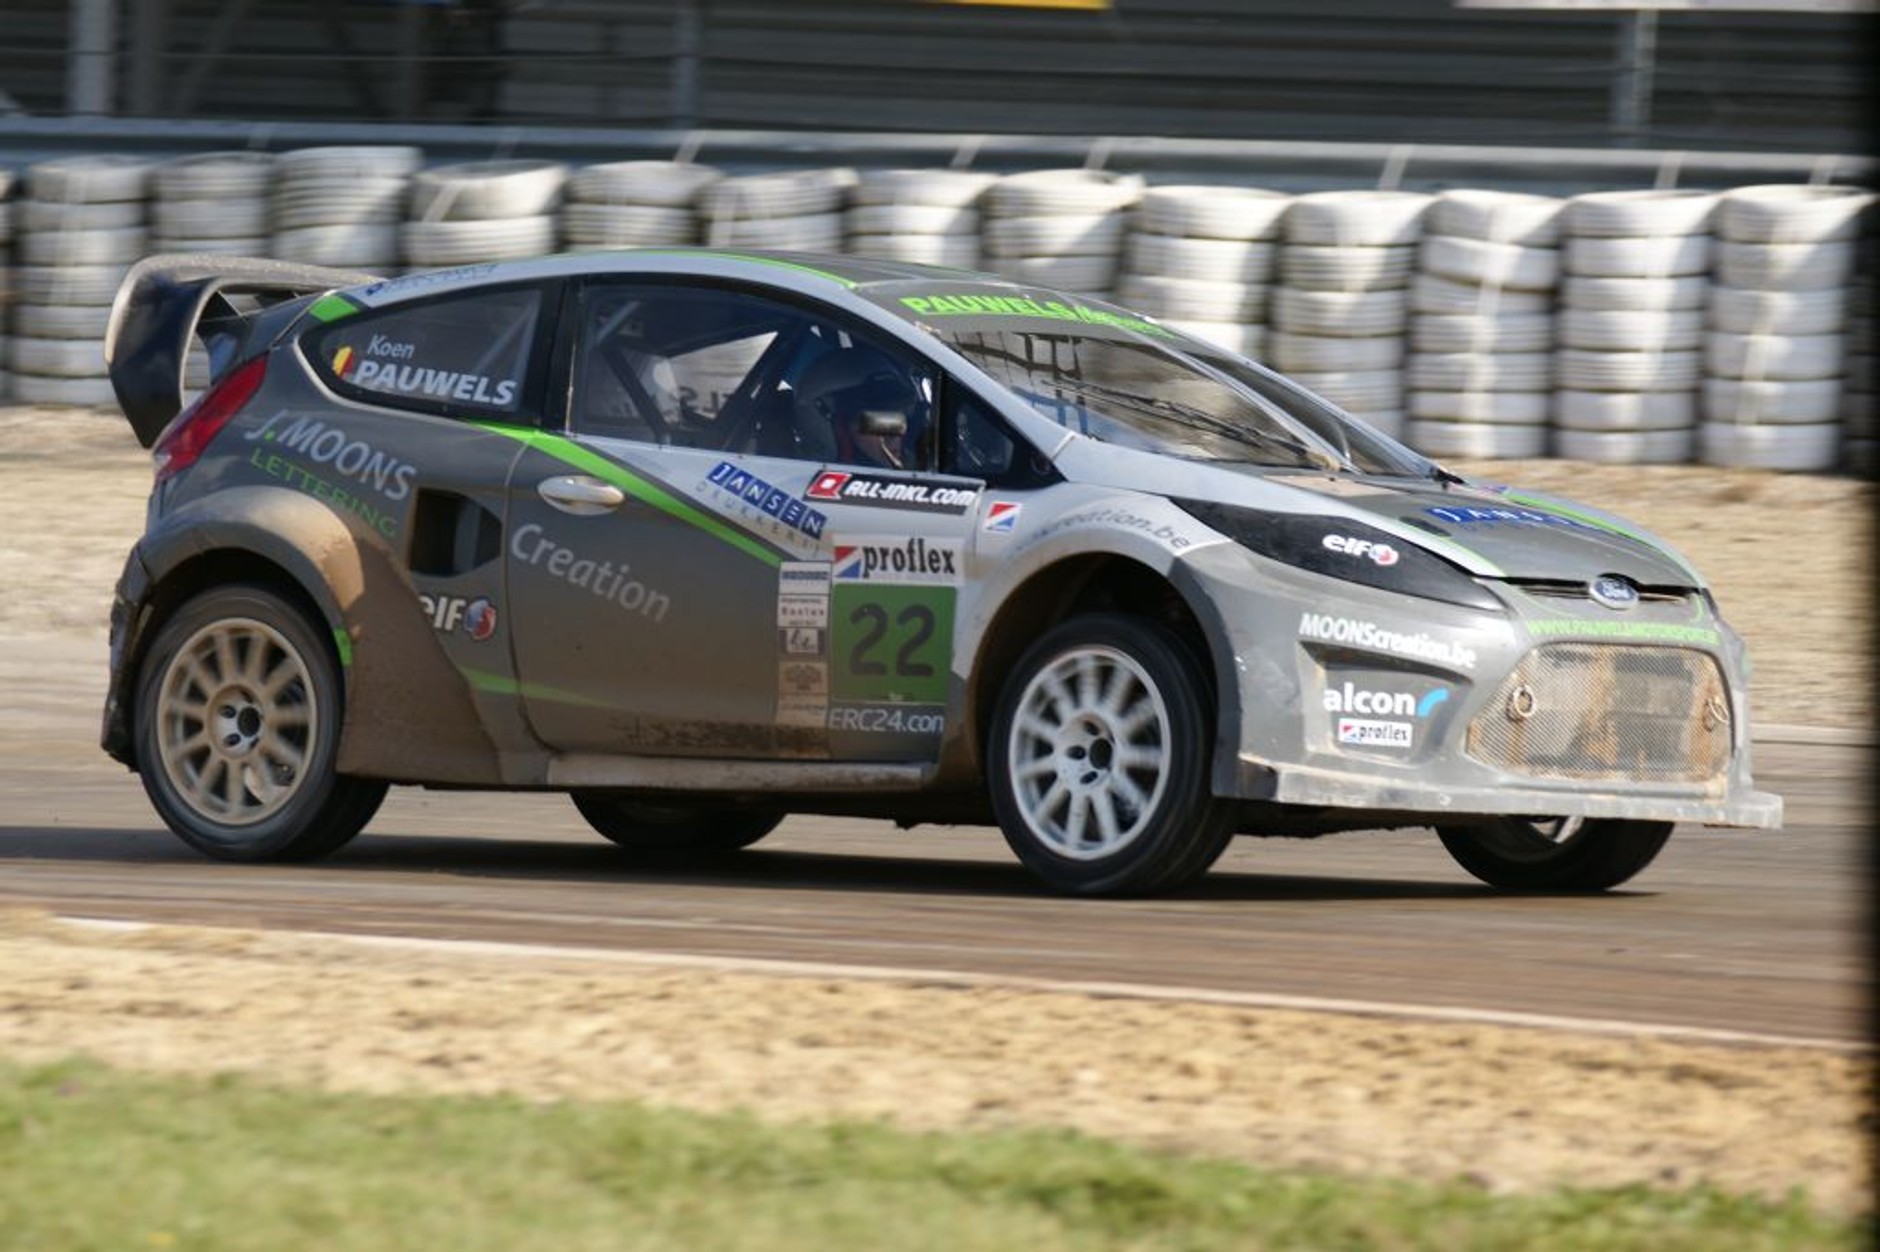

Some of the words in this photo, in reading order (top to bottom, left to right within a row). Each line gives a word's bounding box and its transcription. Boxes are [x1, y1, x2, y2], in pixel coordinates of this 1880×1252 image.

[367, 334, 415, 359] Koen
[353, 360, 517, 405] PAUWELS
[250, 447, 399, 538] LETTERING
[711, 463, 822, 534] JANSEN
[511, 523, 672, 622] Creation
[862, 538, 955, 578] proflex
[851, 602, 935, 677] 22
[1298, 613, 1477, 668] MOONScreation.be
[1322, 682, 1416, 716] alcon
[1358, 724, 1409, 742] proflex
